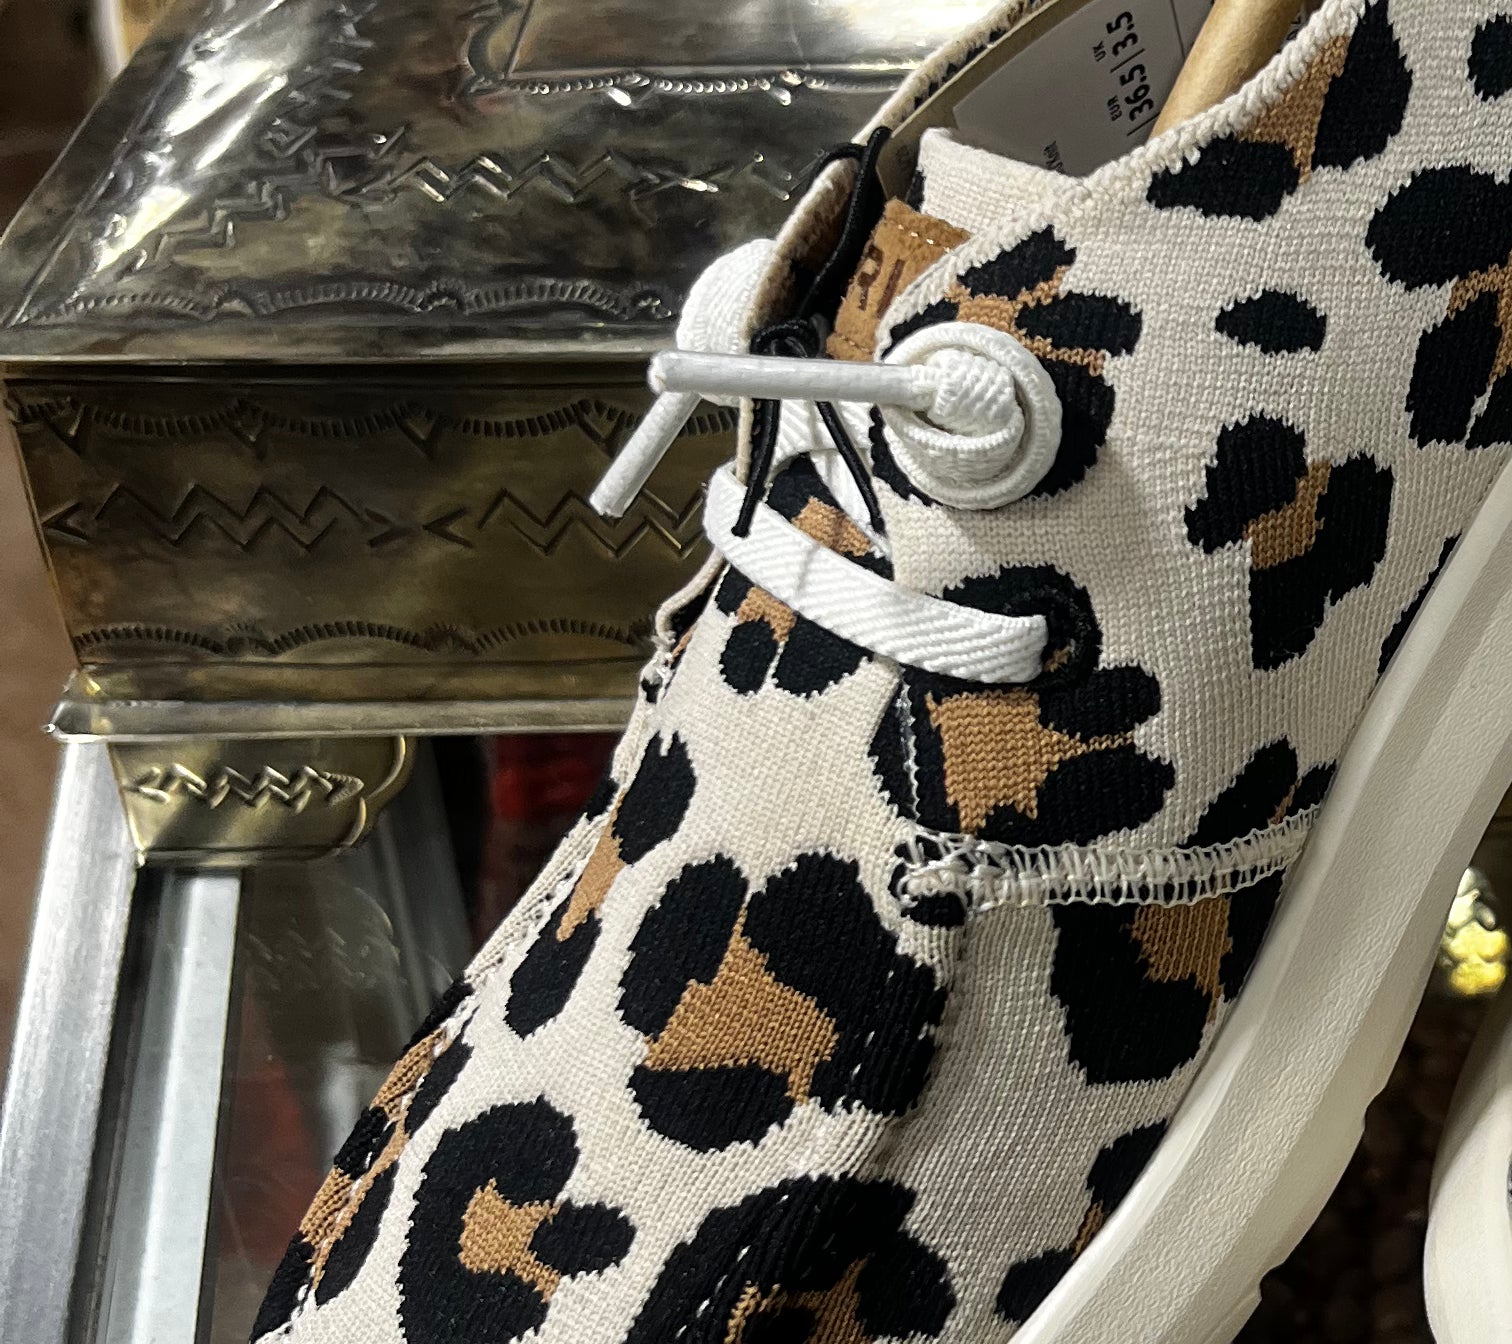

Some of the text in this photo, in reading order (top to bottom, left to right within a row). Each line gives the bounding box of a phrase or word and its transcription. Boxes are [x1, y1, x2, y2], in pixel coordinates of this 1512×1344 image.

[1093, 40, 1122, 122] EUR UK
[1105, 11, 1154, 122] 36.5 3.5
